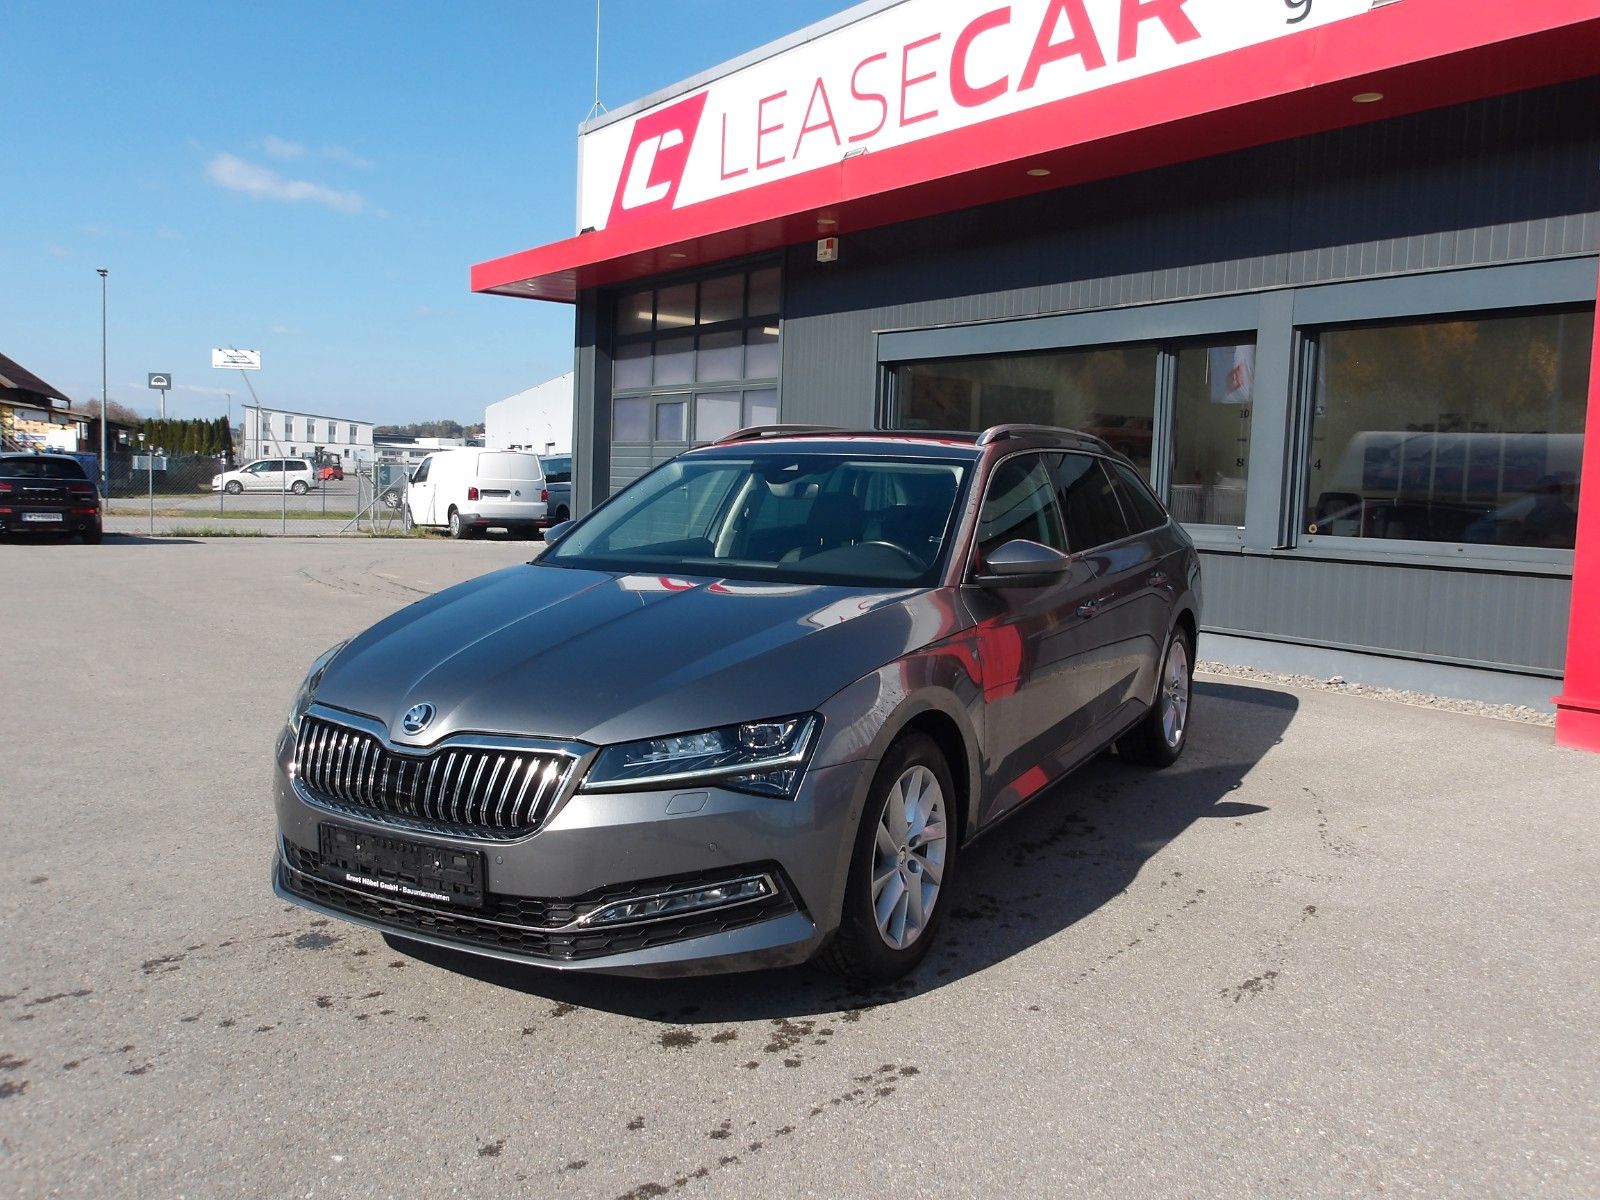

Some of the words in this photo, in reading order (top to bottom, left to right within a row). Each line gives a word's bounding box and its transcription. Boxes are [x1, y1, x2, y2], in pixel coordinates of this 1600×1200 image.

[719, 0, 1202, 182] LEASECAR
[346, 874, 361, 883] Ernst
[362, 877, 379, 887] Höbel
[380, 882, 398, 891] GmbH
[403, 887, 450, 901] Bauunternehmen
